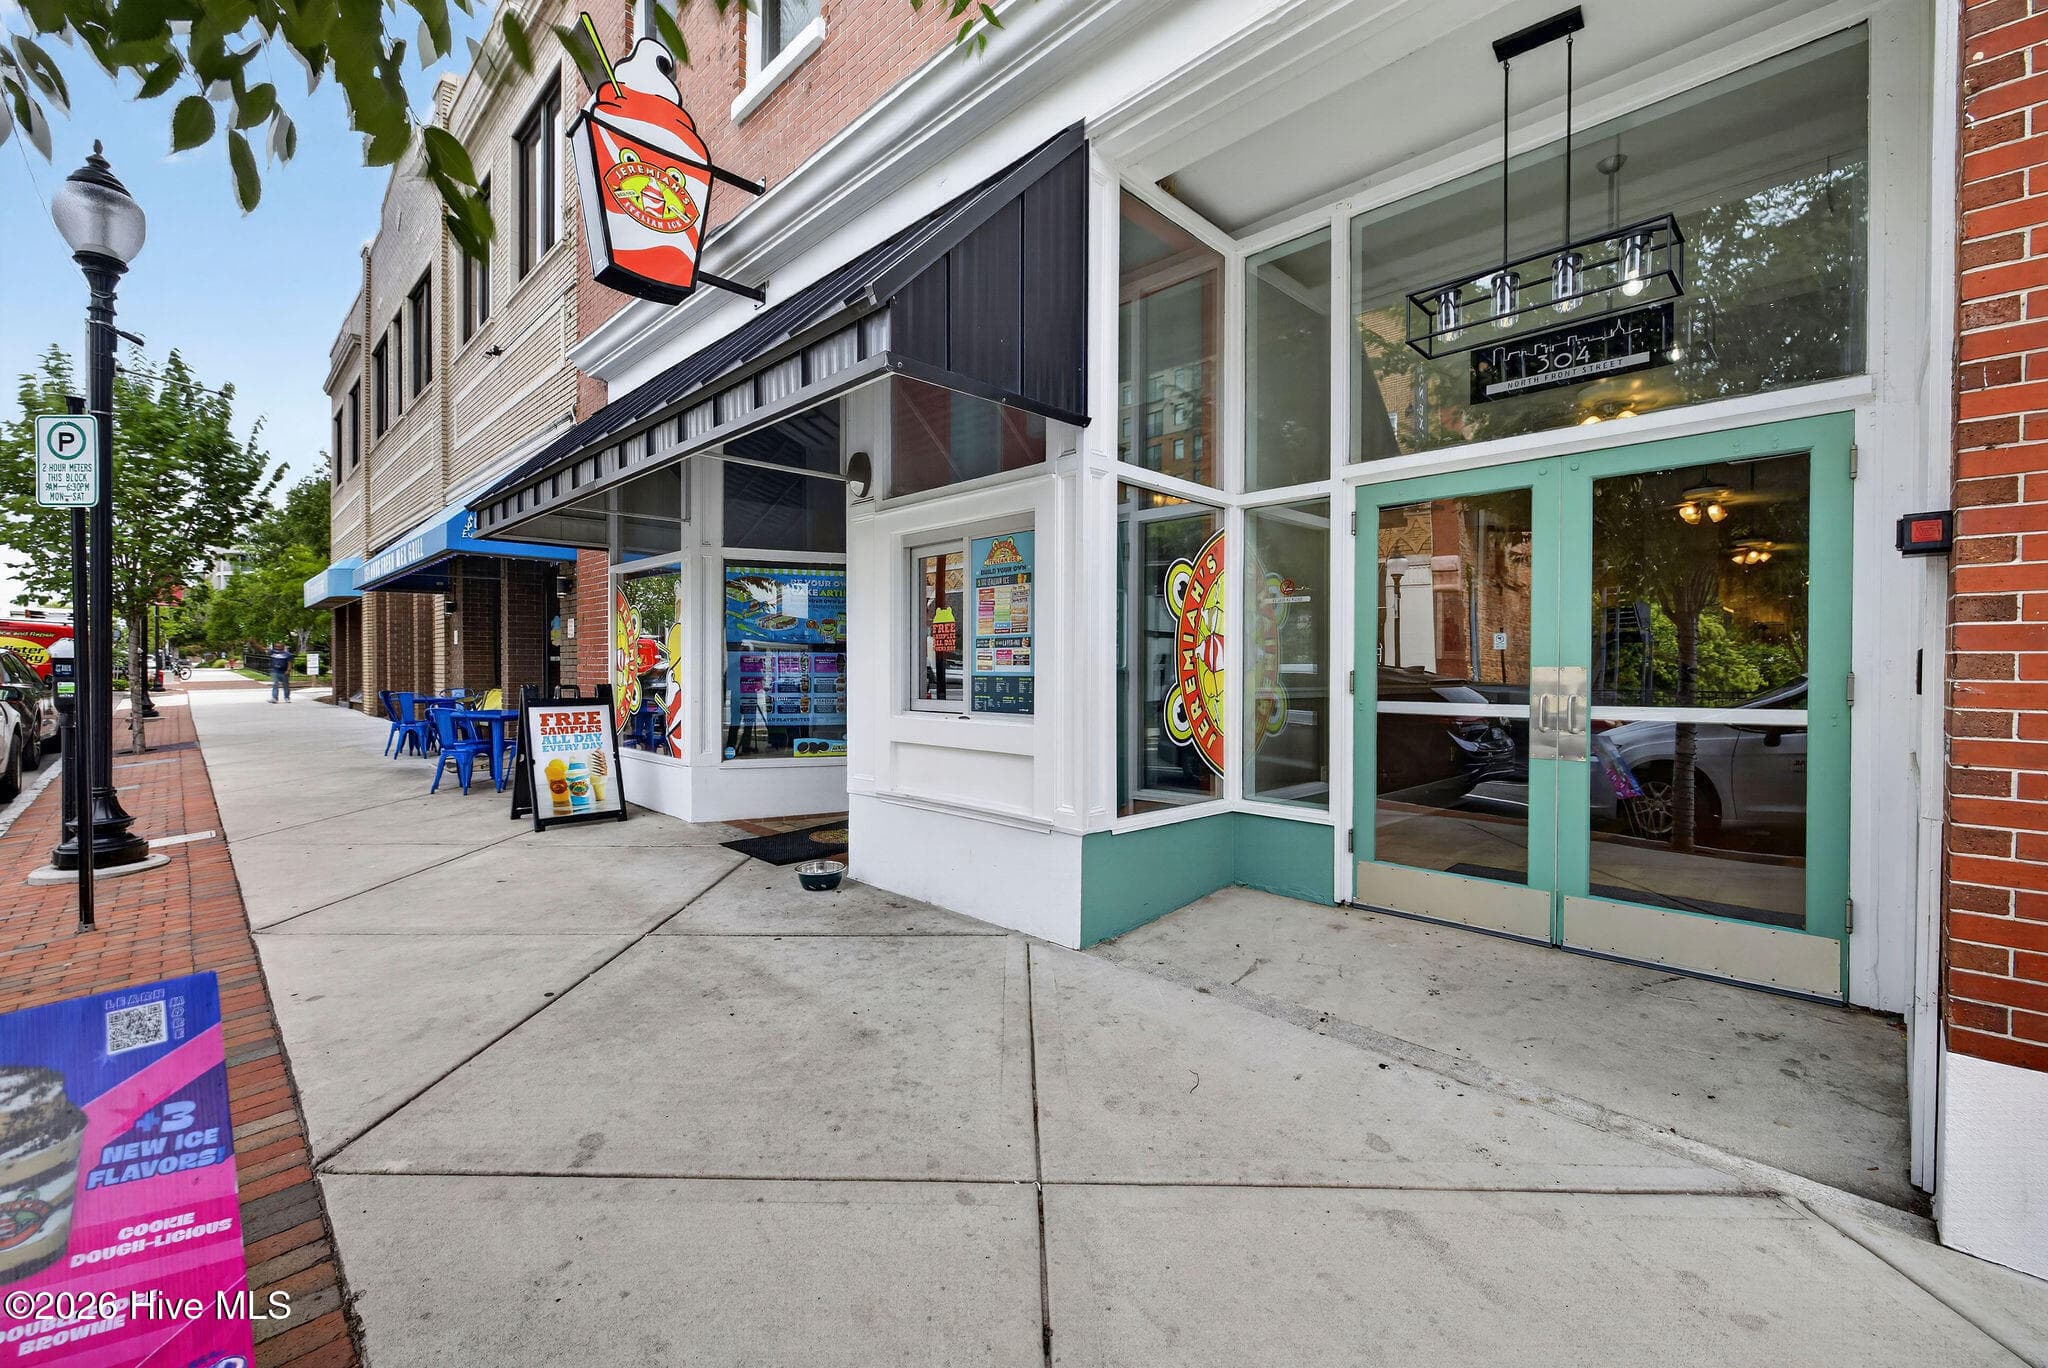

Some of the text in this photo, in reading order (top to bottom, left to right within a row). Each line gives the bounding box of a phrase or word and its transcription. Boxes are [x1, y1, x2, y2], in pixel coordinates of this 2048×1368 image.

[615, 165, 690, 205] JEREMIAH'S
[625, 202, 664, 228] ITALIAN
[667, 219, 682, 229] ICE
[1537, 345, 1590, 373] 304
[1507, 359, 1623, 389] NORTH FRONT STREET
[59, 432, 75, 451] P
[42, 463, 92, 472] 2 HOUR METERS
[66, 474, 87, 482] BLOCK
[933, 623, 956, 633] FREE
[1183, 554, 1217, 749] JEREMIAH'S
[539, 711, 601, 727] FREE
[540, 725, 602, 736] SAMPLES
[541, 733, 602, 745] ALL DAY
[542, 741, 603, 752] EVERY DAY
[105, 988, 165, 1010] LEARN
[170, 996, 185, 1040] MORE
[135, 1101, 196, 1132] +3
[102, 1128, 219, 1165] NEW ICE
[86, 1146, 226, 1190] FLAVORS!
[117, 1212, 196, 1240] COOKIE
[70, 1218, 233, 1268] DOUGH-LICIOUS
[18, 1314, 126, 1357] BROWNIE
